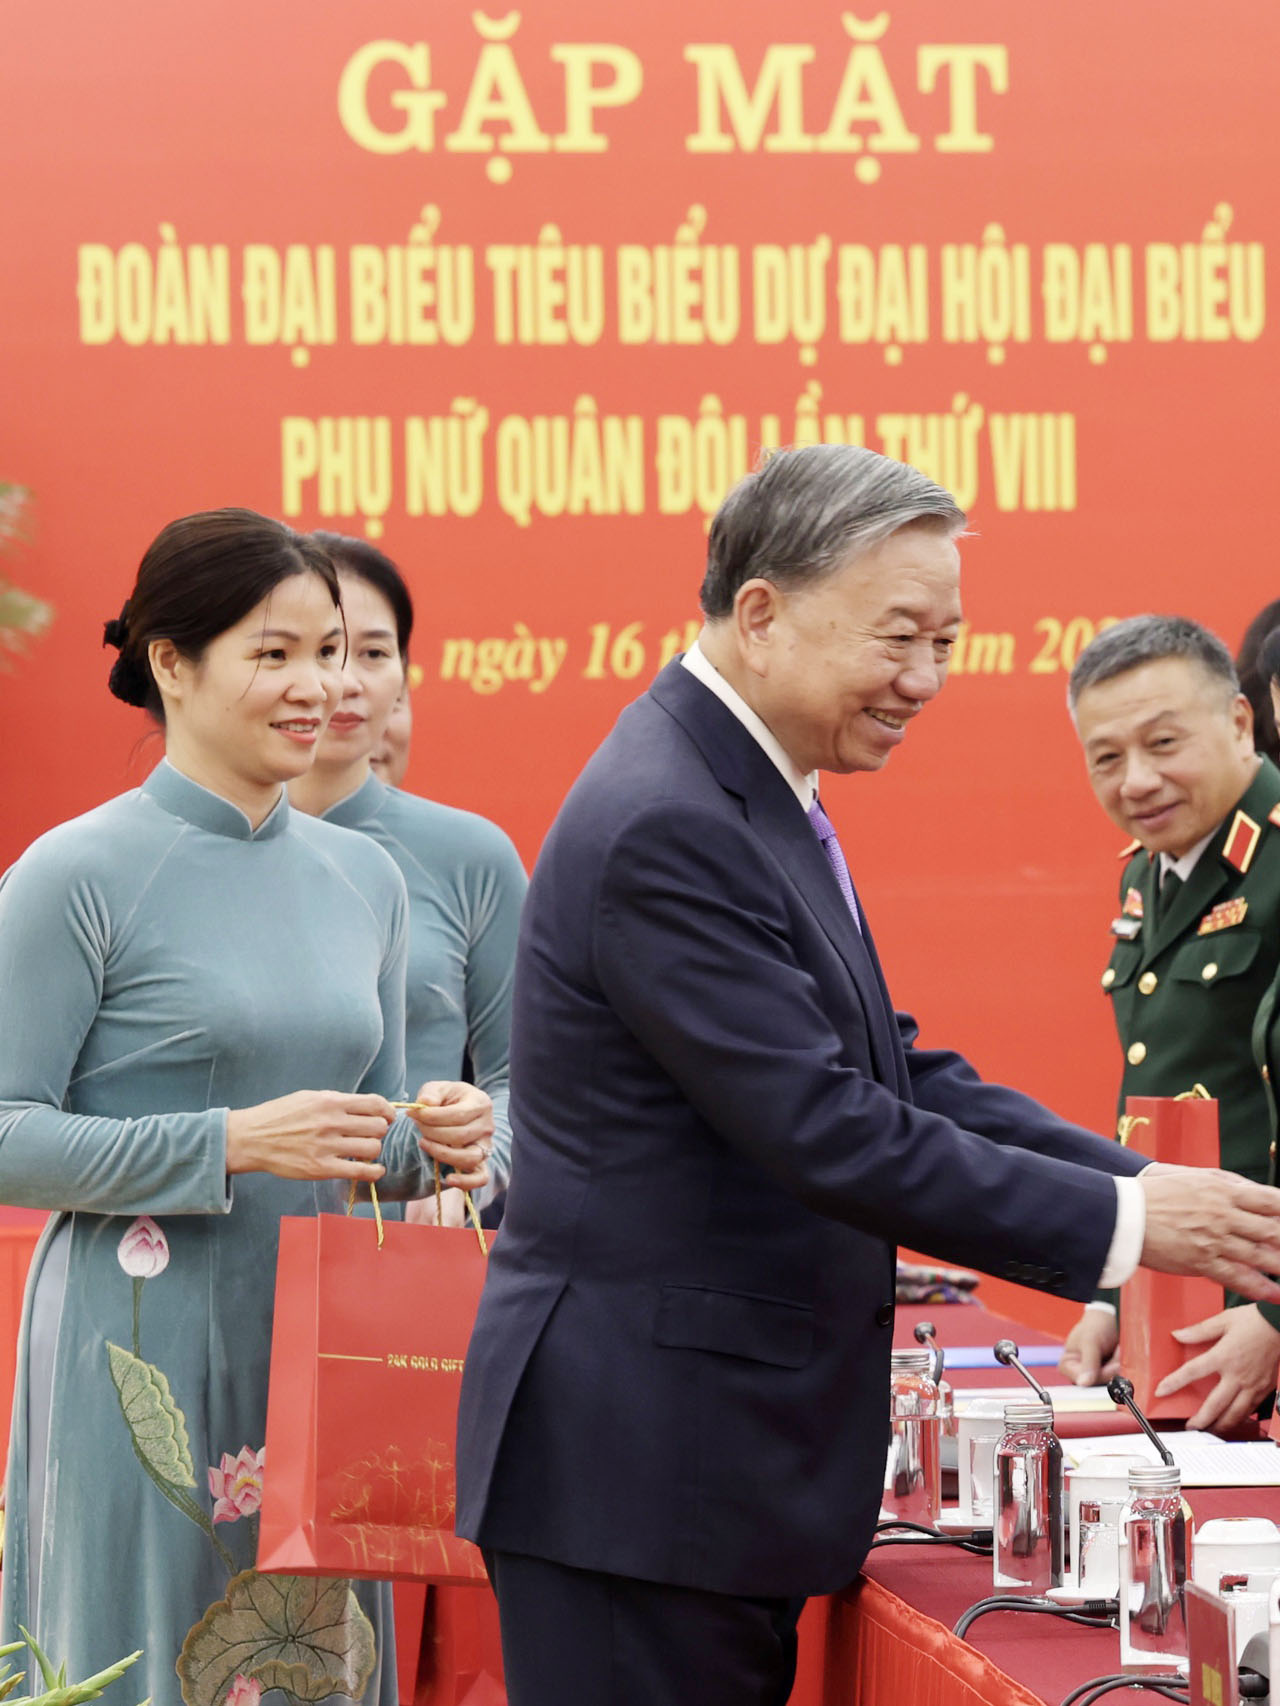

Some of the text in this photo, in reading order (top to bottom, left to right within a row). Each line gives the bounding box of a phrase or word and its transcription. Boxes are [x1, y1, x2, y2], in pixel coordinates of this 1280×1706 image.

[338, 10, 1008, 183] GẶP MẶT
[78, 202, 1266, 367] ĐOÀN ĐẠI BIỂU TIÊU BIỂU DỰ ĐẠI HỘI ĐẠI BIỂU
[281, 416, 392, 538] PHỤ
[405, 396, 489, 517] NỮ
[497, 394, 644, 527] QUÂN
[656, 393, 748, 535] ĐỘI
[988, 412, 1077, 512] VIII
[440, 622, 569, 695] ngày
[583, 621, 646, 680] 16
